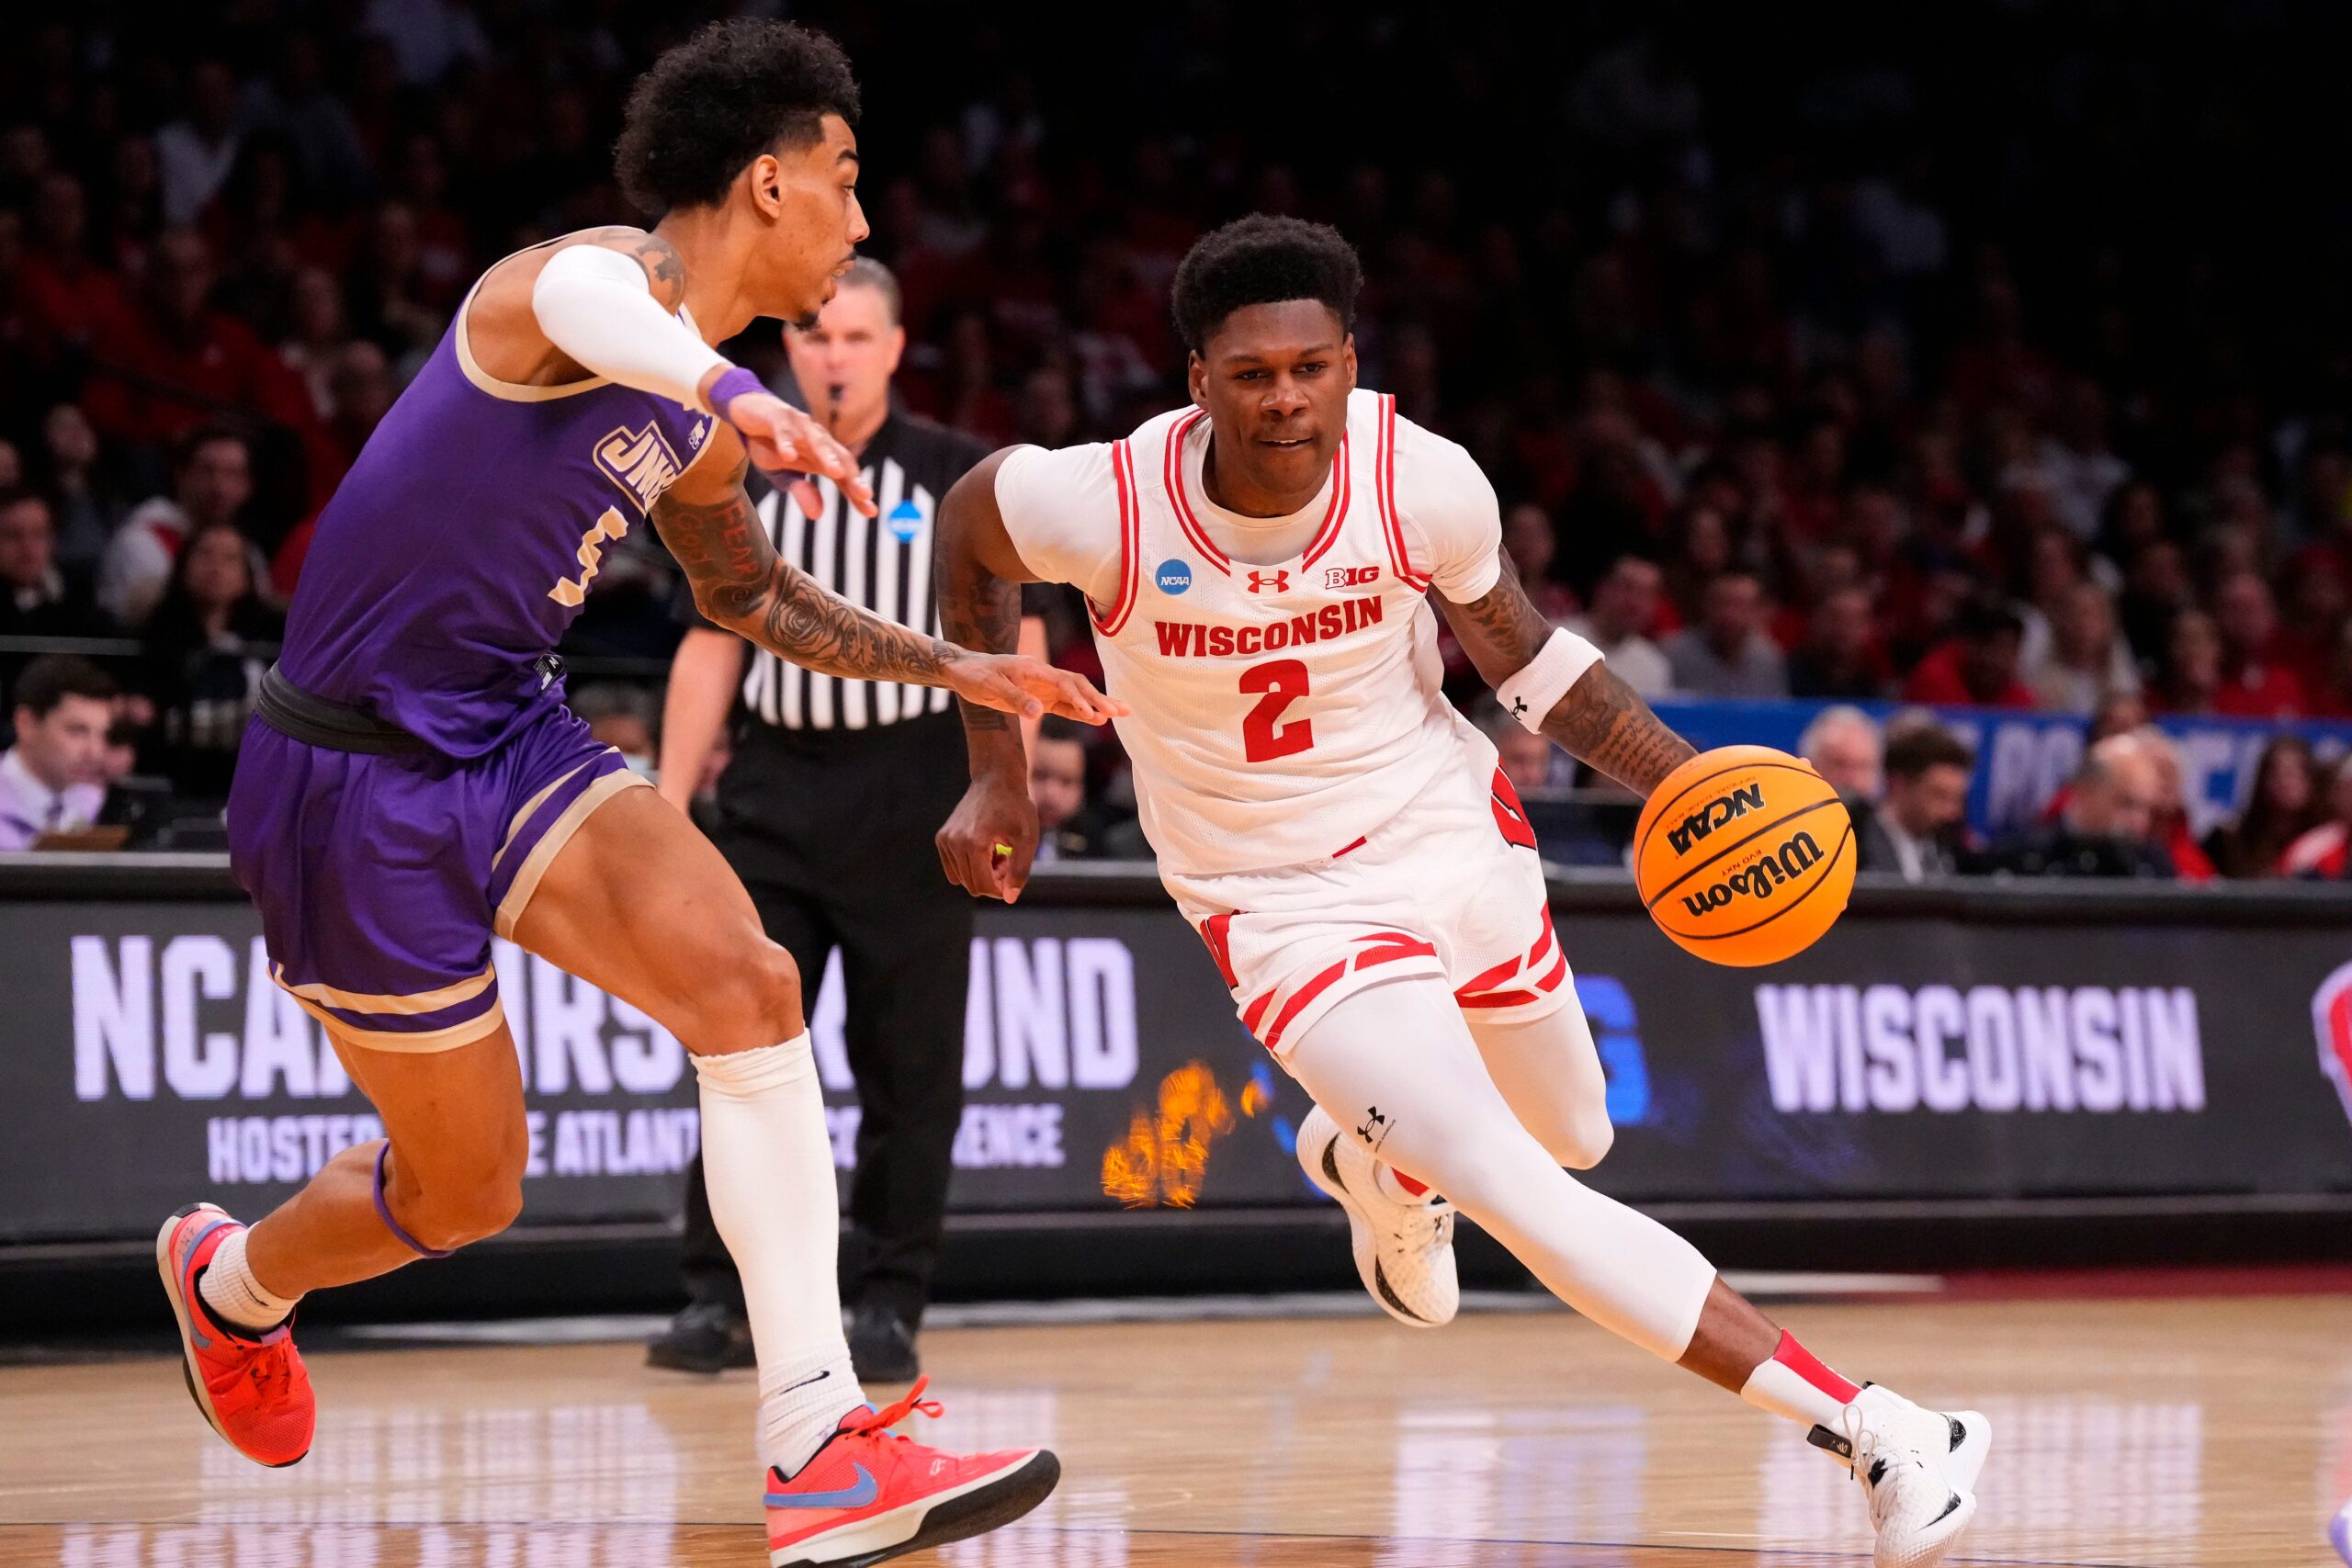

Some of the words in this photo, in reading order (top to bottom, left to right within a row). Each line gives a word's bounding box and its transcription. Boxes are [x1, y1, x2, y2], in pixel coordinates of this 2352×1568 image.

[1160, 575, 1190, 587] NCAA
[1155, 595, 1383, 657] WISCONSIN
[1239, 659, 1314, 762] 2
[1667, 783, 1765, 857] NCAA
[1682, 831, 1825, 917] Wilson
[1722, 863, 1741, 877] NXT
[1742, 849, 1762, 864] EVO
[70, 934, 350, 1101] NCA
[491, 934, 685, 1096] IRS
[1754, 983, 2207, 1114] WISCONSIN
[555, 1108, 701, 1178] ATLANT
